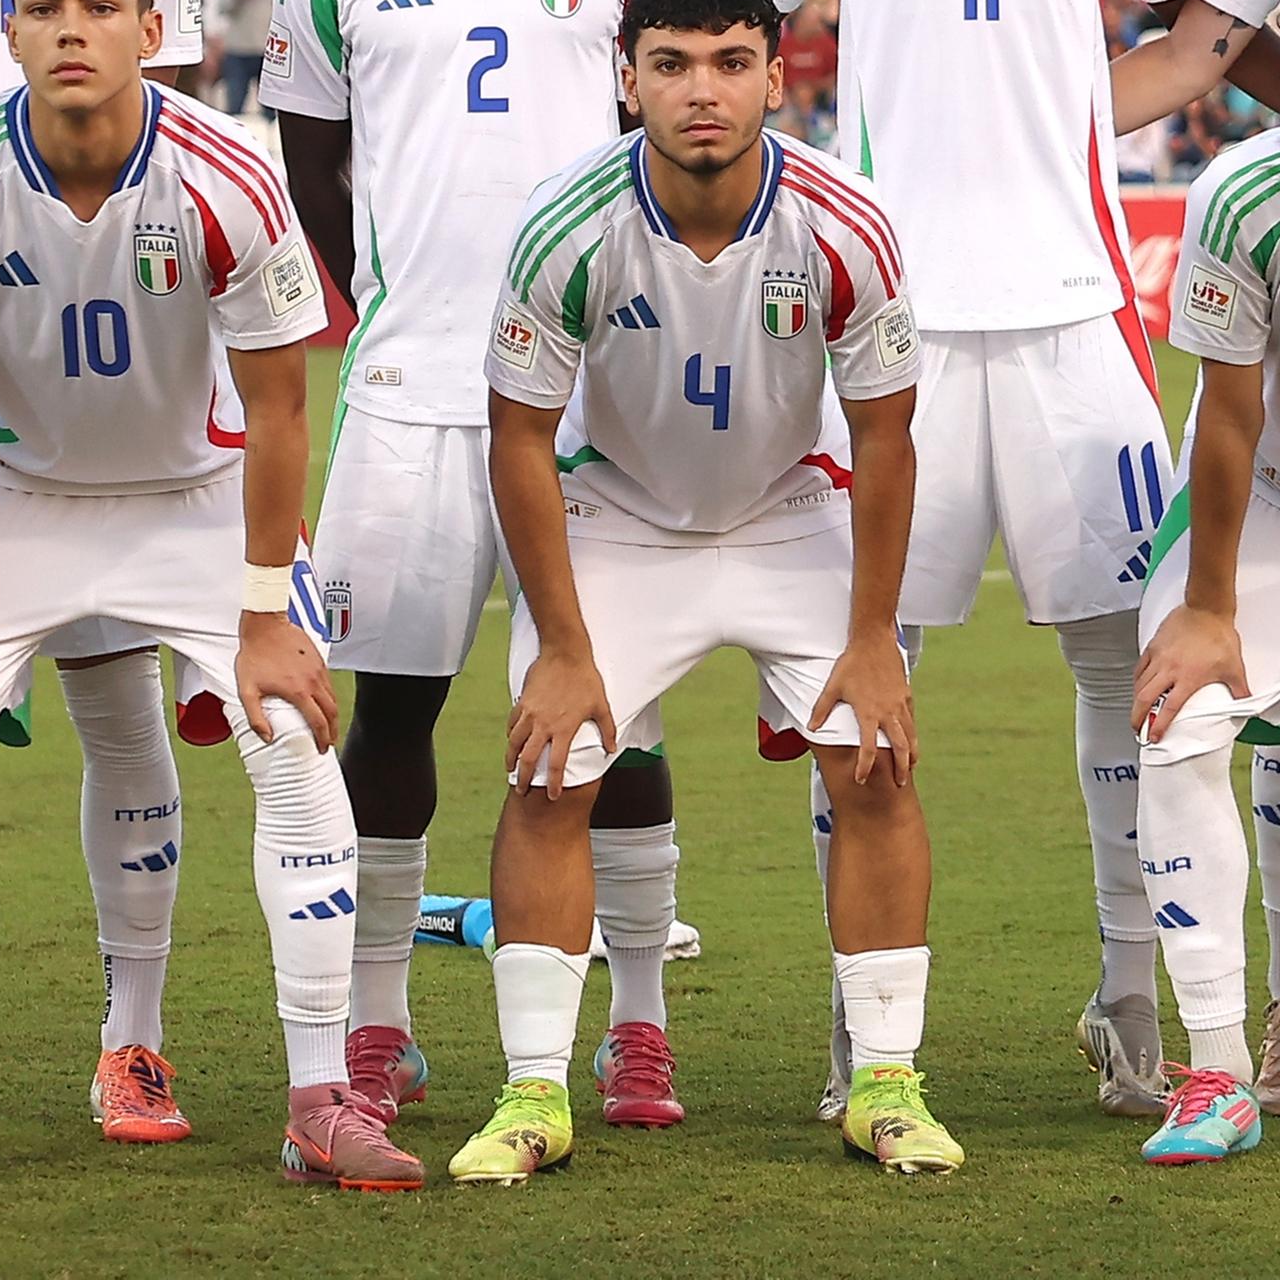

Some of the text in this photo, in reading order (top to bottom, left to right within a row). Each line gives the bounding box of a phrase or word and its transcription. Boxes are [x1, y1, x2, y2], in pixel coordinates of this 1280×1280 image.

[466, 26, 510, 113] 2
[138, 239, 175, 253] ITALIA
[274, 262, 302, 287] UNITES
[1204, 280, 1219, 290] FIFA
[765, 285, 804, 299] ITALIA
[1192, 282, 1230, 307] U17
[1191, 296, 1227, 314] WORLD CUP
[61, 299, 132, 379] 10
[515, 340, 529, 352] CUP
[684, 352, 732, 431] 4
[1118, 440, 1166, 533] 11
[326, 594, 349, 605] ITALIA
[280, 845, 356, 869] ITALIA
